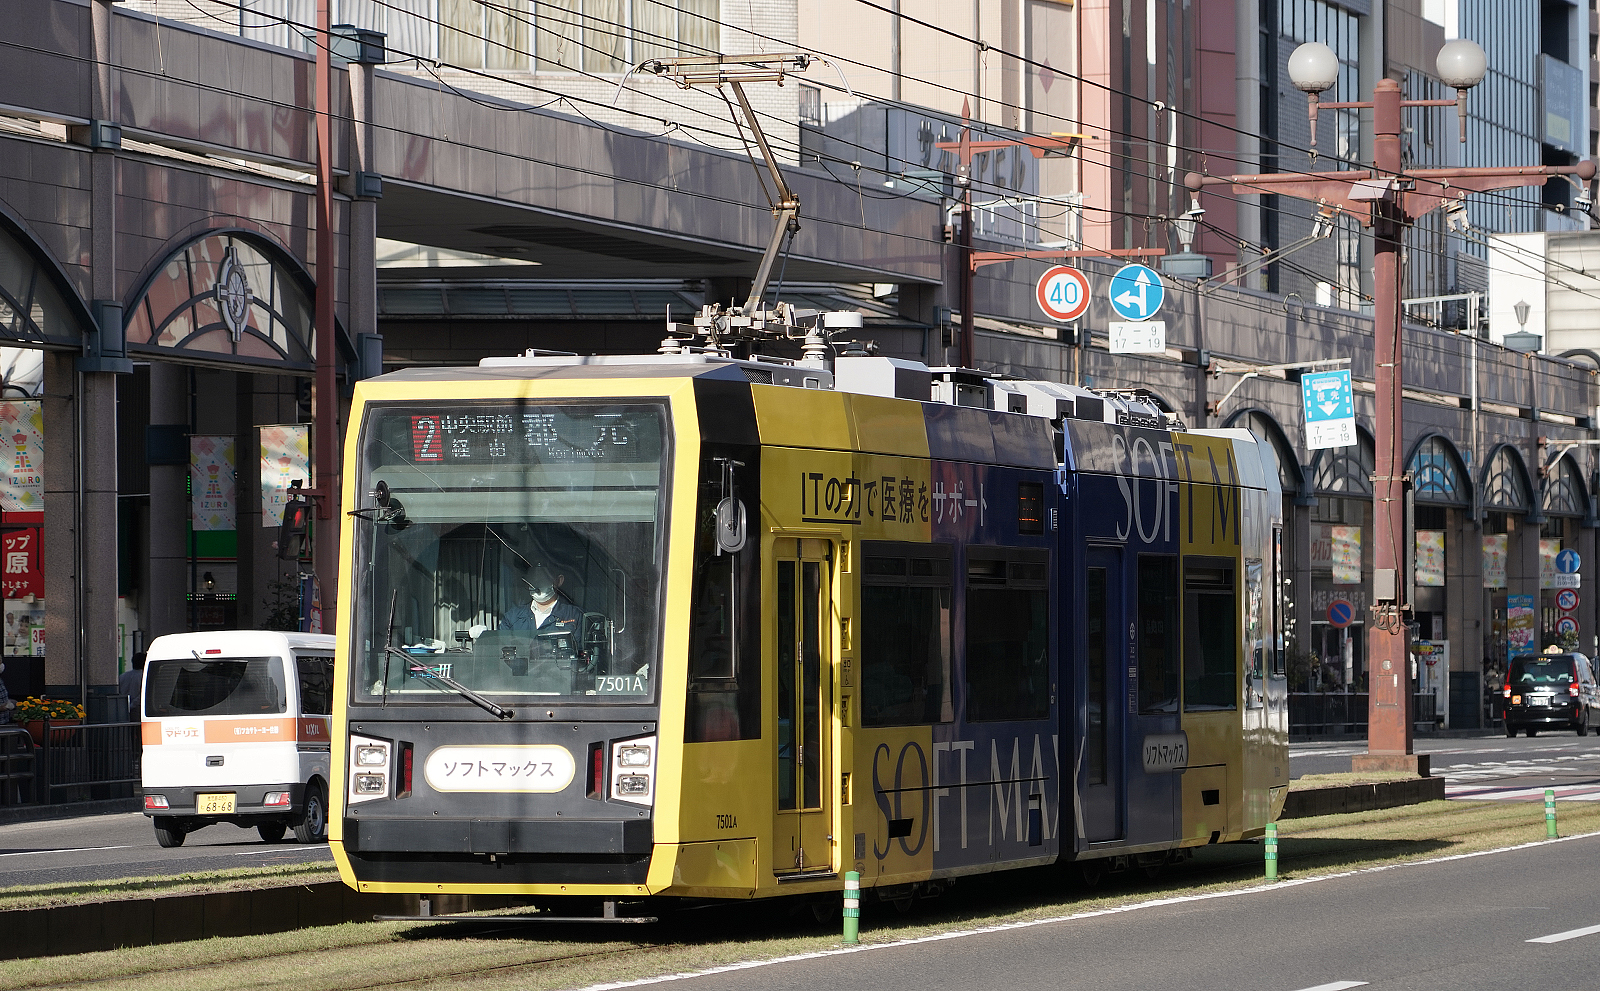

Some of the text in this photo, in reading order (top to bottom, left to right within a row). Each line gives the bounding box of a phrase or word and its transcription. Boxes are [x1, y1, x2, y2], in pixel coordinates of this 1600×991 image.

[1050, 282, 1078, 304] 40
[1117, 326, 1124, 337] 7
[1150, 325, 1157, 336] 9
[1115, 339, 1127, 349] 17
[1148, 338, 1160, 349] 19
[1314, 425, 1320, 435] 7
[1341, 423, 1347, 432] 9
[417, 417, 438, 458] 2
[1313, 435, 1322, 445] 17
[1340, 433, 1350, 442] 19
[9, 476, 40, 485] IZURO
[1111, 433, 1194, 544] SOFT
[5, 535, 30, 550] ップ
[5, 551, 29, 574] 原
[597, 677, 644, 692] 7501A
[165, 729, 200, 738] マドリエ
[305, 723, 320, 736] LIXIL
[1145, 743, 1185, 765] ソフトマックス
[443, 759, 556, 778] ソフトマックス
[872, 733, 1086, 860] SOFT MAX
[206, 801, 232, 812] 68-68
[715, 813, 738, 830] 7501A
